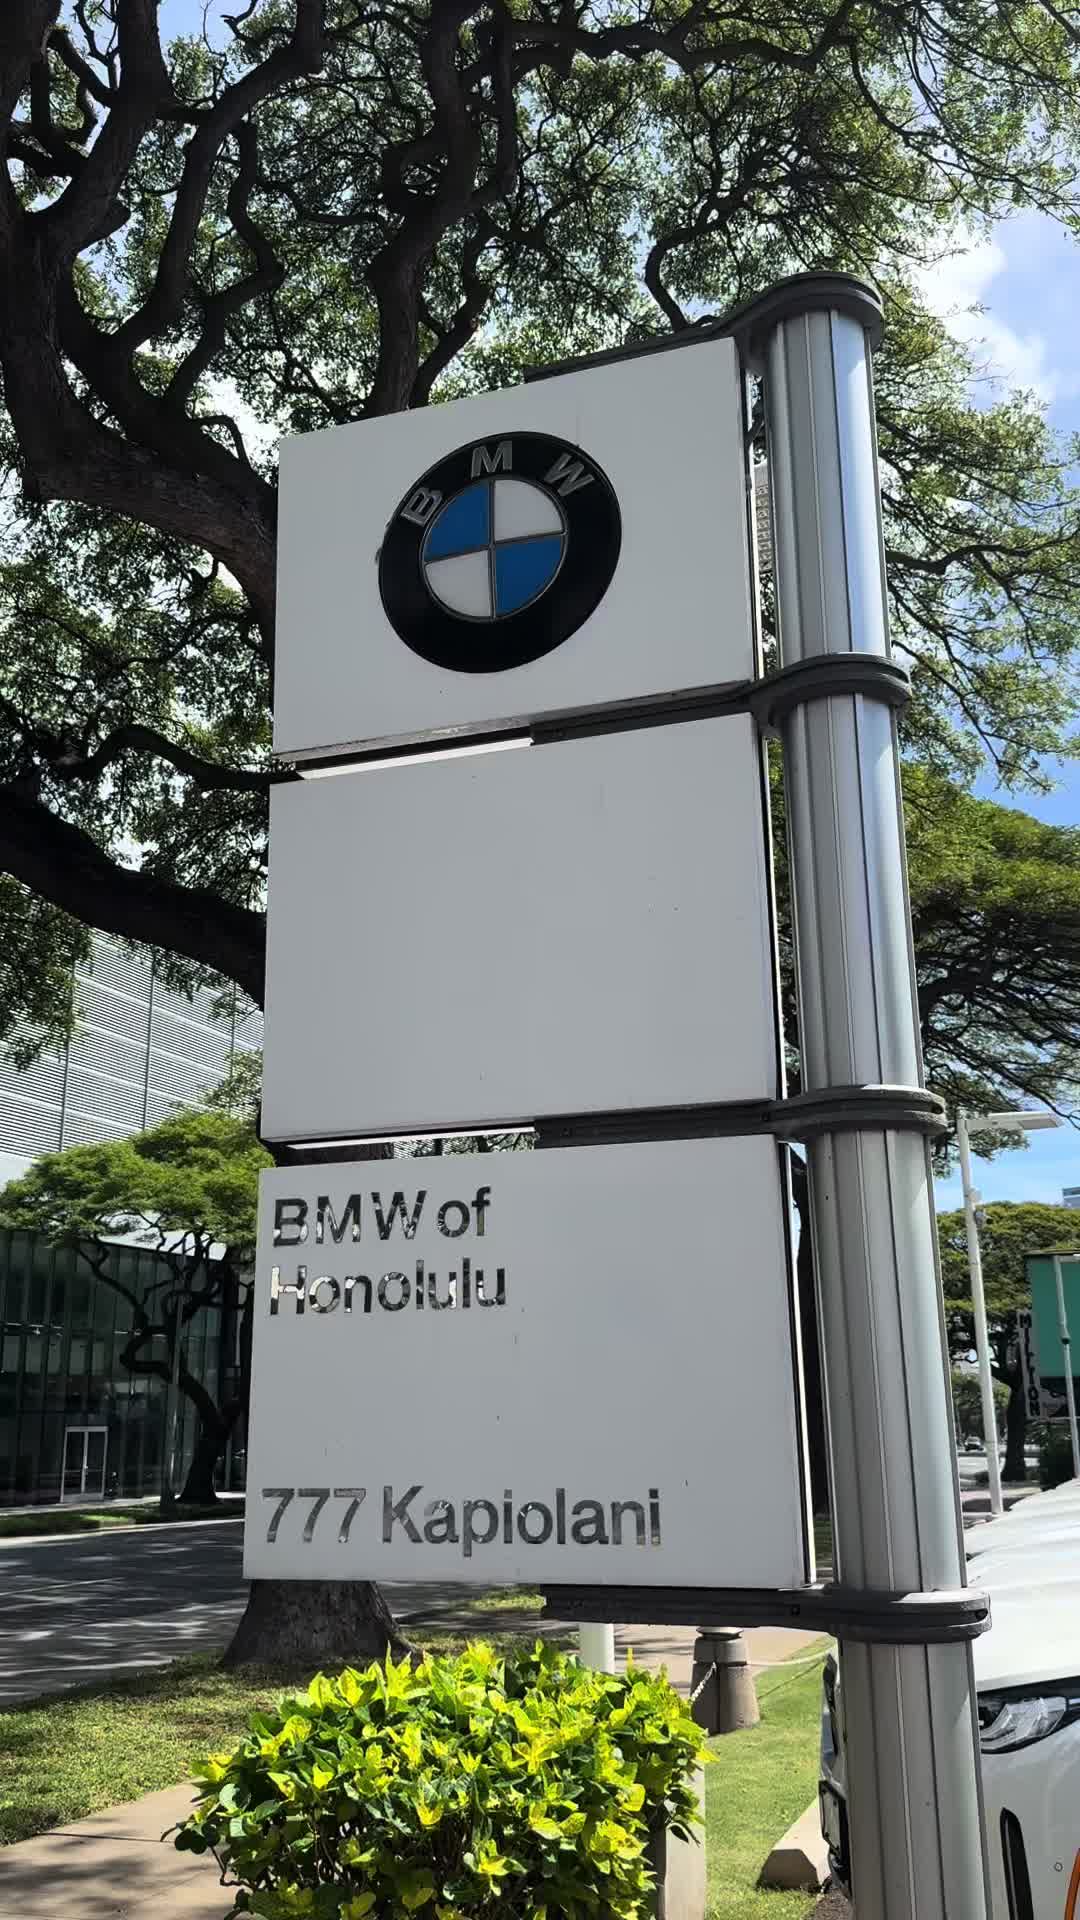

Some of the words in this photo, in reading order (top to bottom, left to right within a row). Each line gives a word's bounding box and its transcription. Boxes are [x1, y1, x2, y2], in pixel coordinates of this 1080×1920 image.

[401, 440, 595, 526] BMW
[273, 1190, 427, 1247] BMW
[437, 1186, 491, 1238] of
[270, 1257, 507, 1315] Honolulu
[262, 1487, 367, 1543] 777
[382, 1485, 662, 1558] Kapiolani
